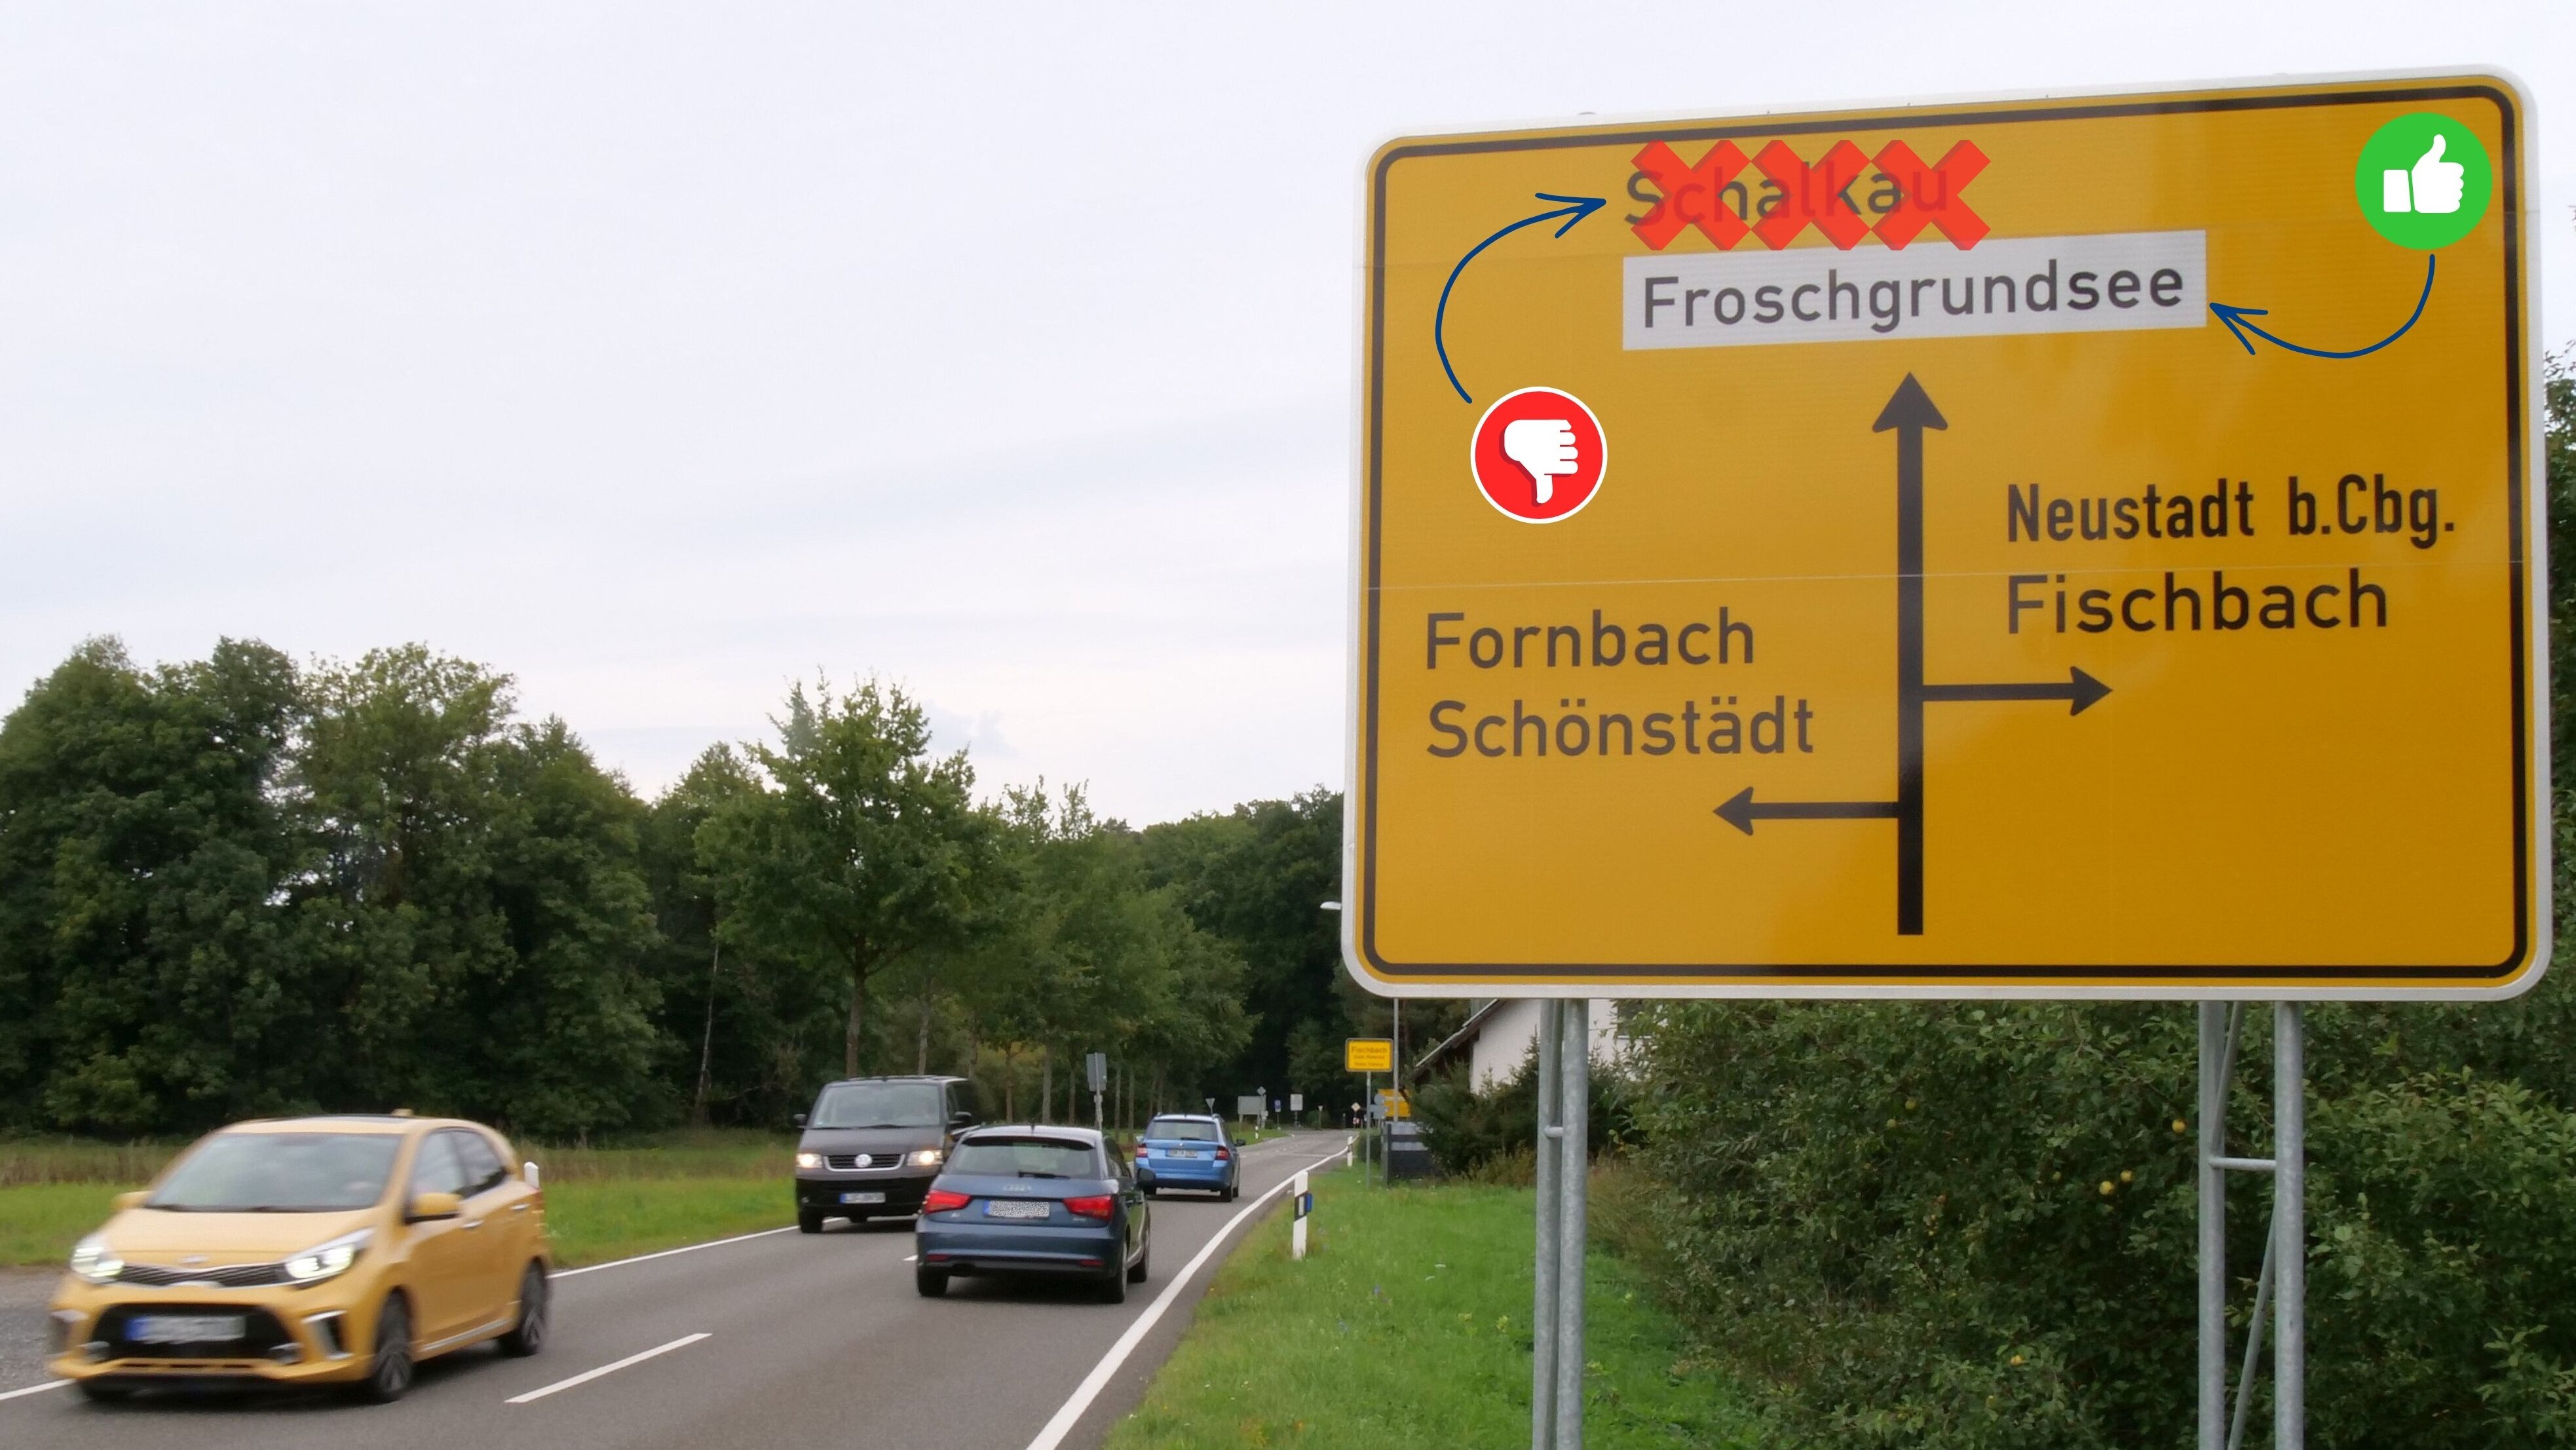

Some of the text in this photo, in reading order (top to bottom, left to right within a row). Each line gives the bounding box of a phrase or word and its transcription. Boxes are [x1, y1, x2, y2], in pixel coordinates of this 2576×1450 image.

[1624, 159, 1948, 227] Schalkau
[1643, 259, 2184, 333] Froschgrundsee
[2007, 473, 2455, 550] Neustadt b.Cbg.
[2008, 567, 2389, 634] Fischbach
[1426, 605, 1754, 670] Fornbach
[1426, 695, 1814, 758] Schönstädt
